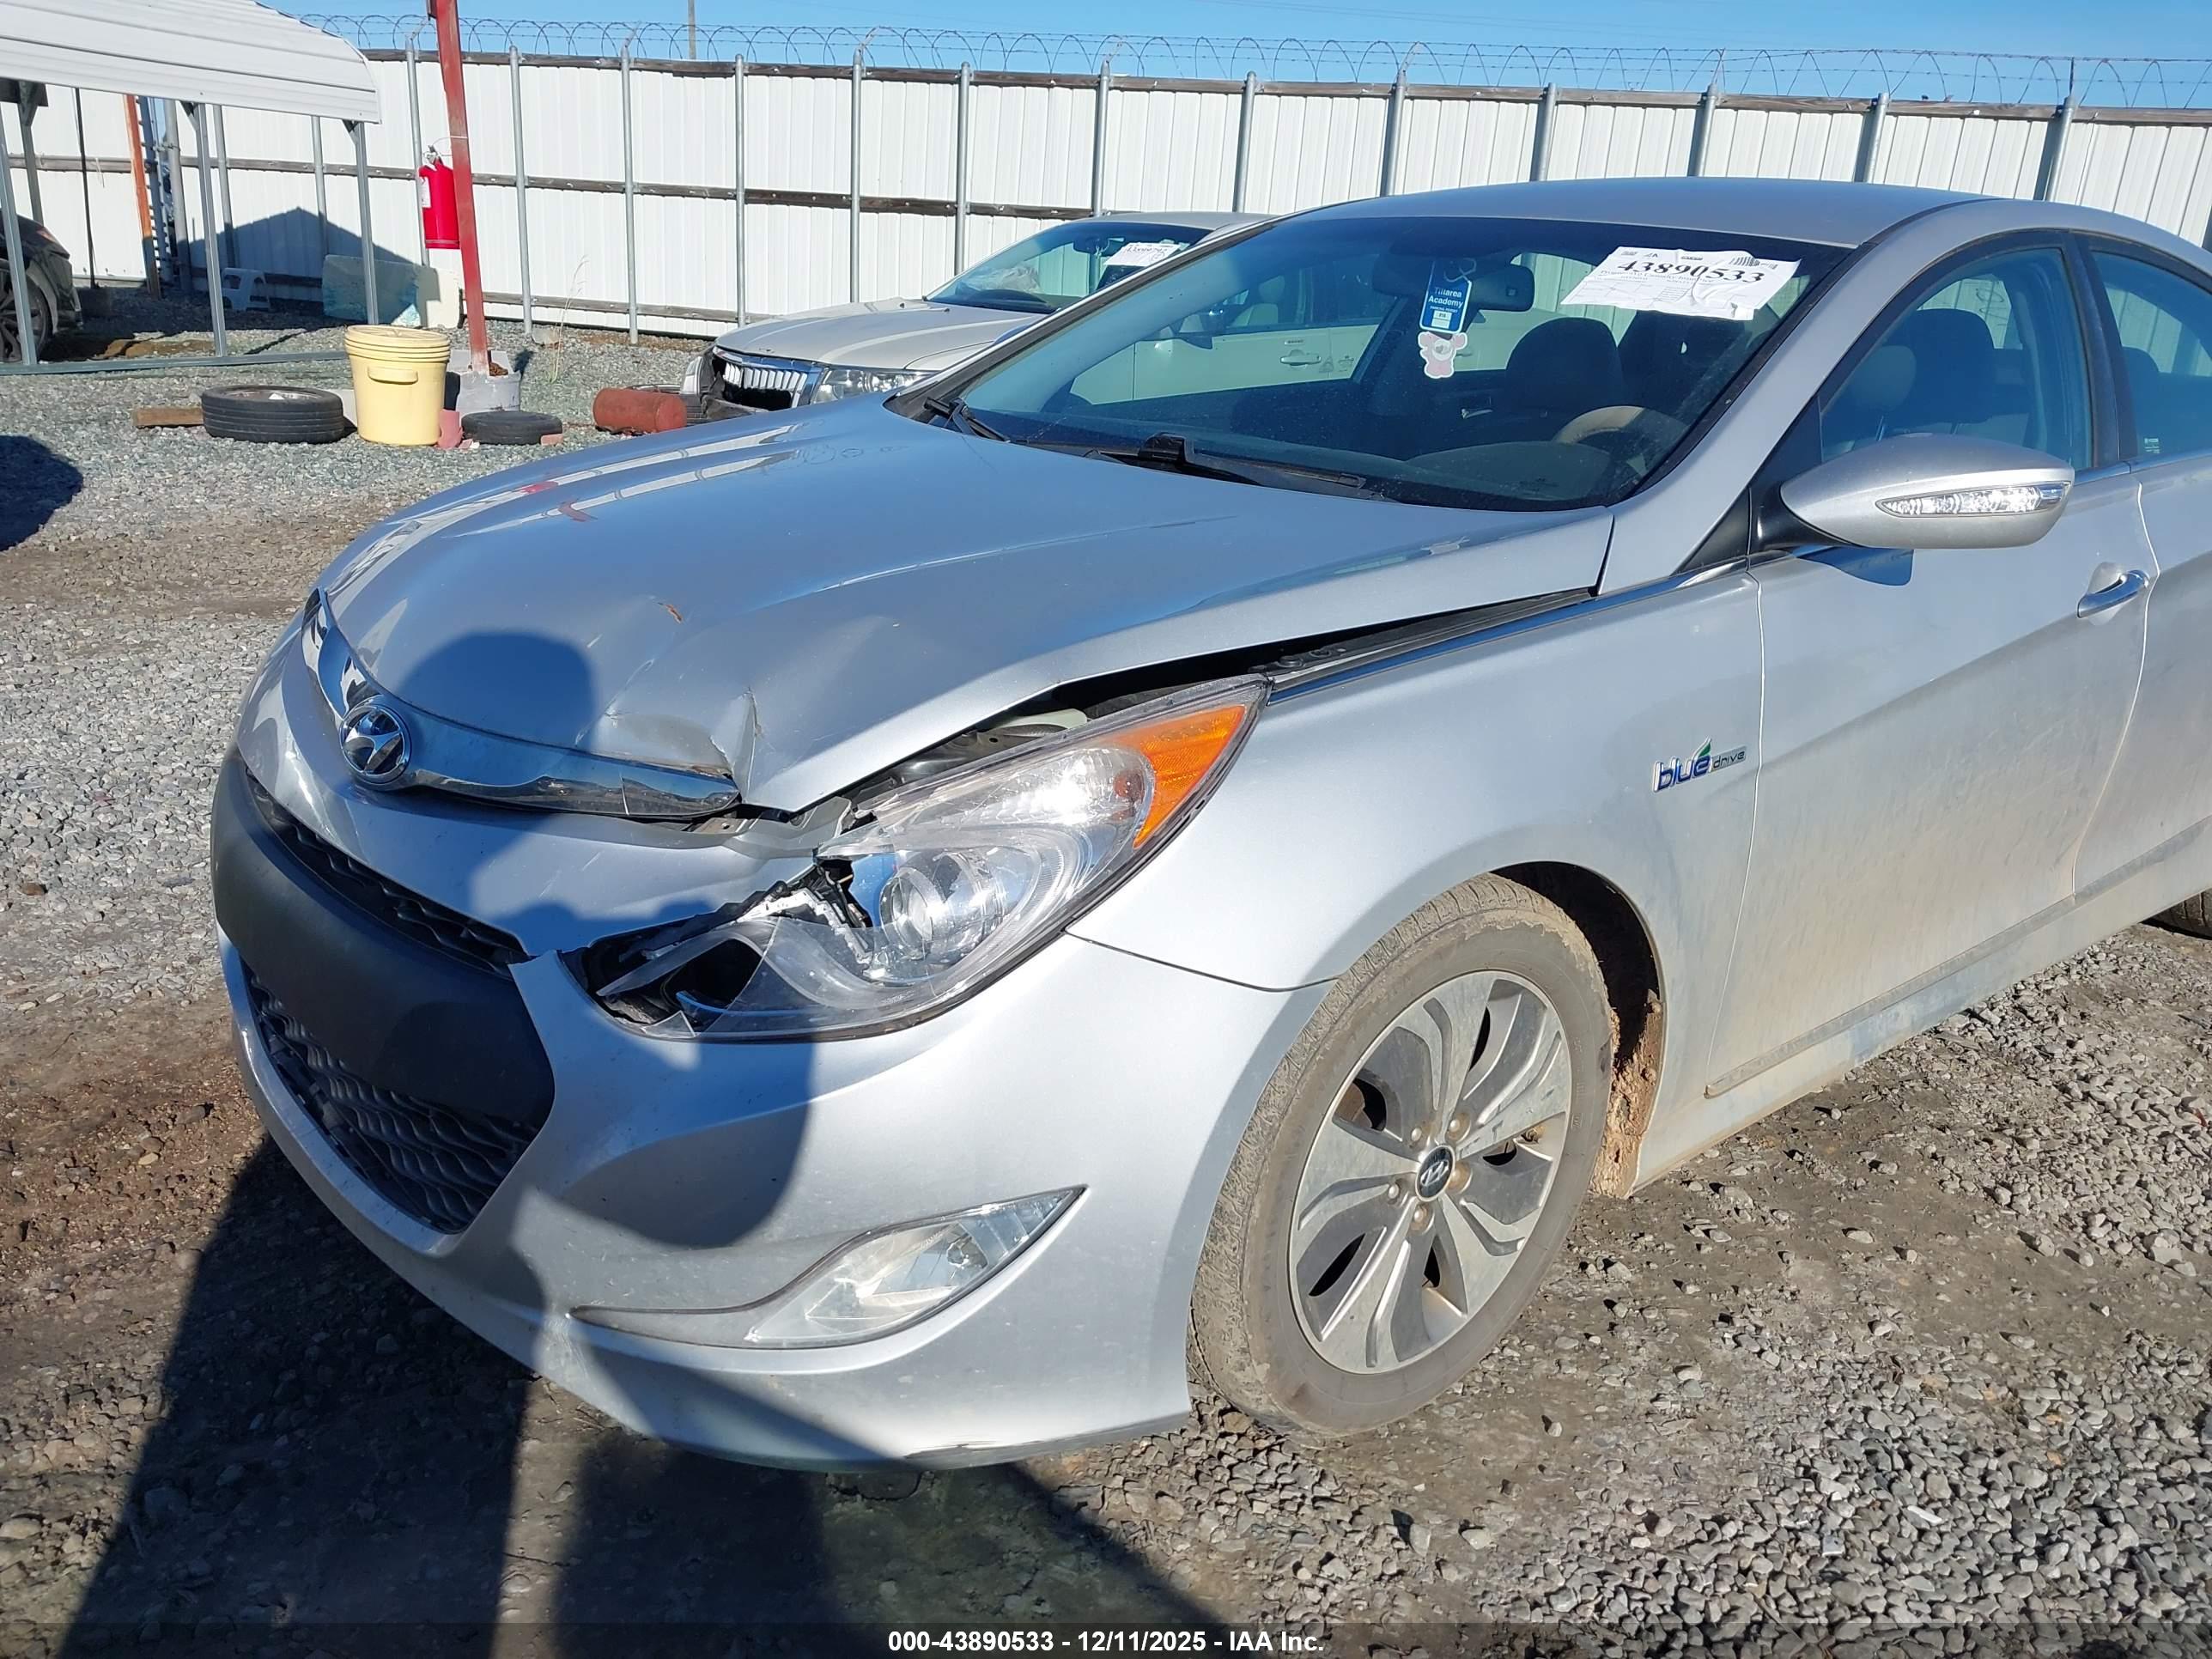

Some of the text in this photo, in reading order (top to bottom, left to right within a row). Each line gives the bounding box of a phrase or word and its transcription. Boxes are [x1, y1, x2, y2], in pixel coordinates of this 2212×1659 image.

[1618, 259, 1765, 283] 43890533
[1428, 295, 1463, 308] Academy
[1653, 750, 1746, 793] blue drive
